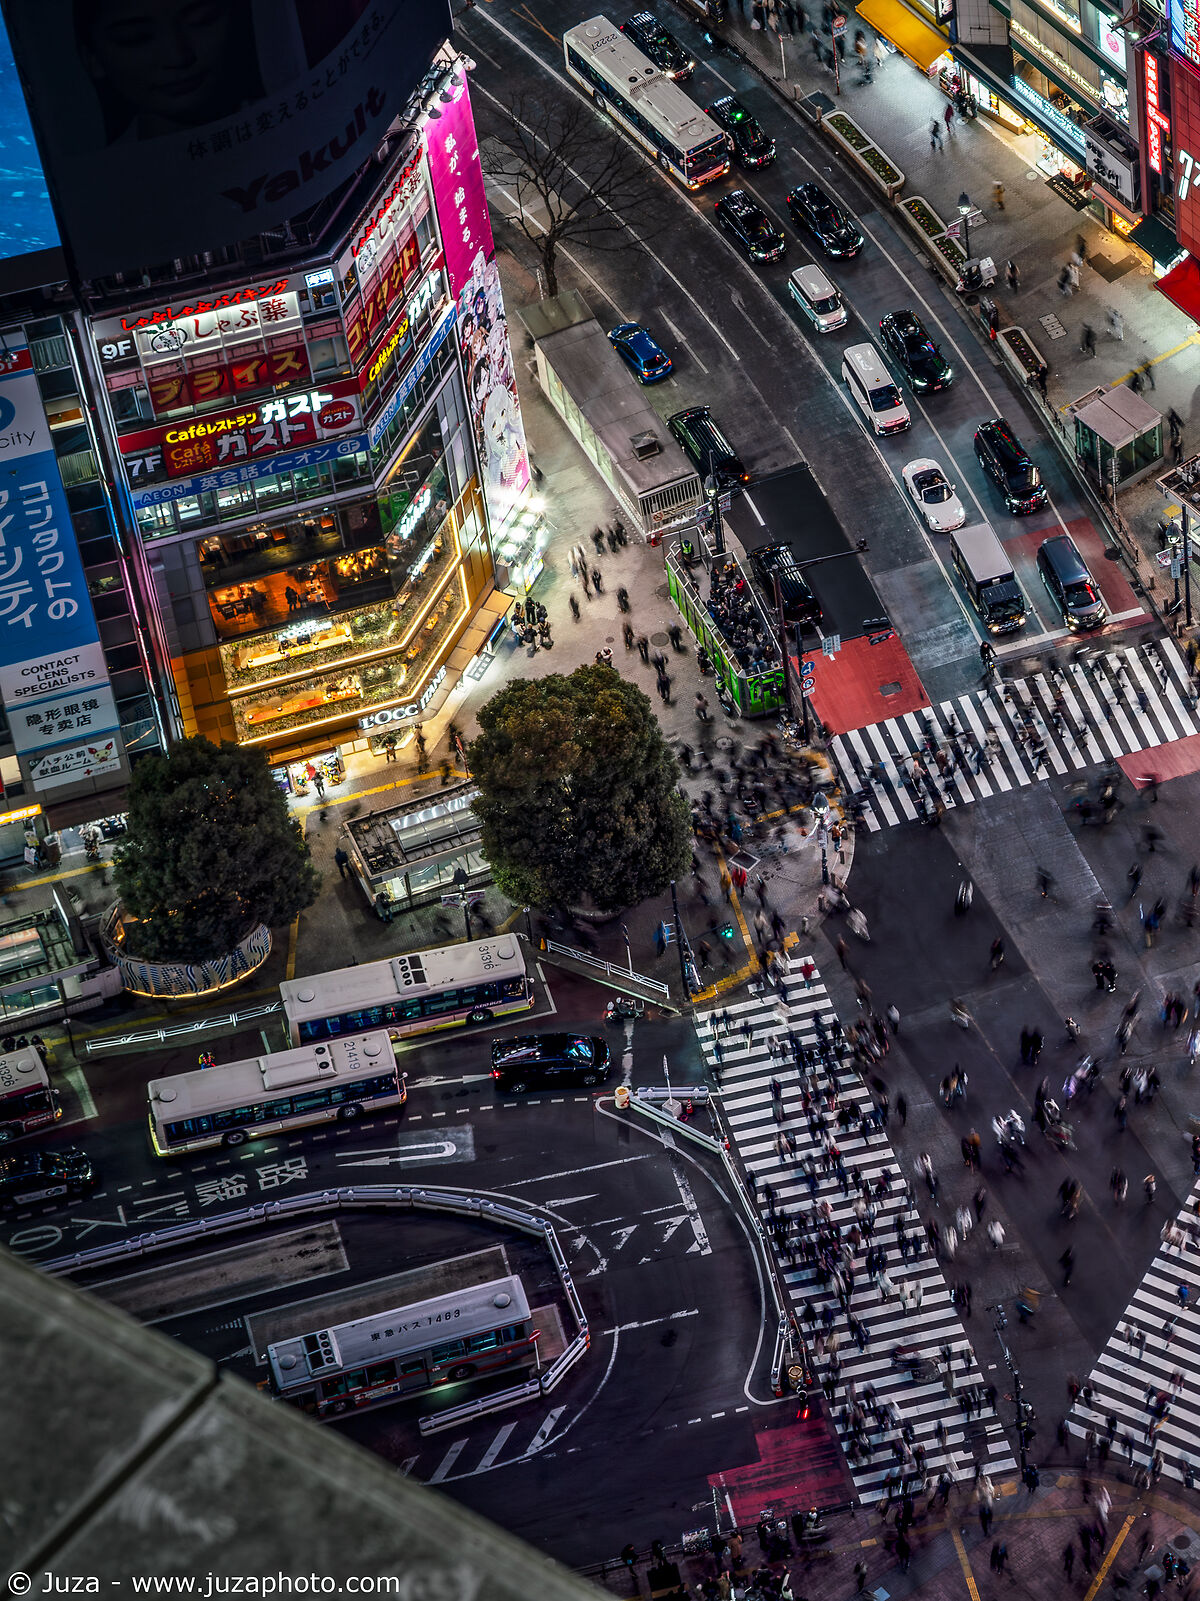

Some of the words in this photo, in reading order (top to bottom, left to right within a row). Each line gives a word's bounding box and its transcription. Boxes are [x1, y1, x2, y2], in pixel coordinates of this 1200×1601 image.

[591, 33, 617, 51] 22227
[220, 86, 386, 213] Yakult
[121, 279, 289, 331] しゃぶしゃぶバイキング
[194, 298, 288, 338] しゃぶ葉
[101, 339, 131, 360] 9F
[151, 350, 302, 405] プライス
[262, 391, 333, 425] ガスト
[322, 410, 352, 424] ガスト
[170, 441, 211, 460] Café
[217, 421, 306, 461] ガスト
[126, 454, 161, 477] 7F
[141, 485, 185, 504] AEON
[200, 448, 330, 492] 英会話イーオン
[340, 439, 358, 454] 6F
[19, 480, 79, 620] コンタクトの
[21, 654, 80, 676] CONTACT
[37, 668, 69, 682] LENS
[14, 670, 96, 697] SPECIALISTS
[25, 698, 101, 727] 隐形眼镜
[39, 714, 92, 735] 专卖店
[41, 750, 87, 768] ハチ公前
[478, 945, 495, 970] 31316
[343, 1041, 361, 1070] 21419
[371, 1321, 421, 1342] 東急バス
[428, 1309, 461, 1325] 1463
